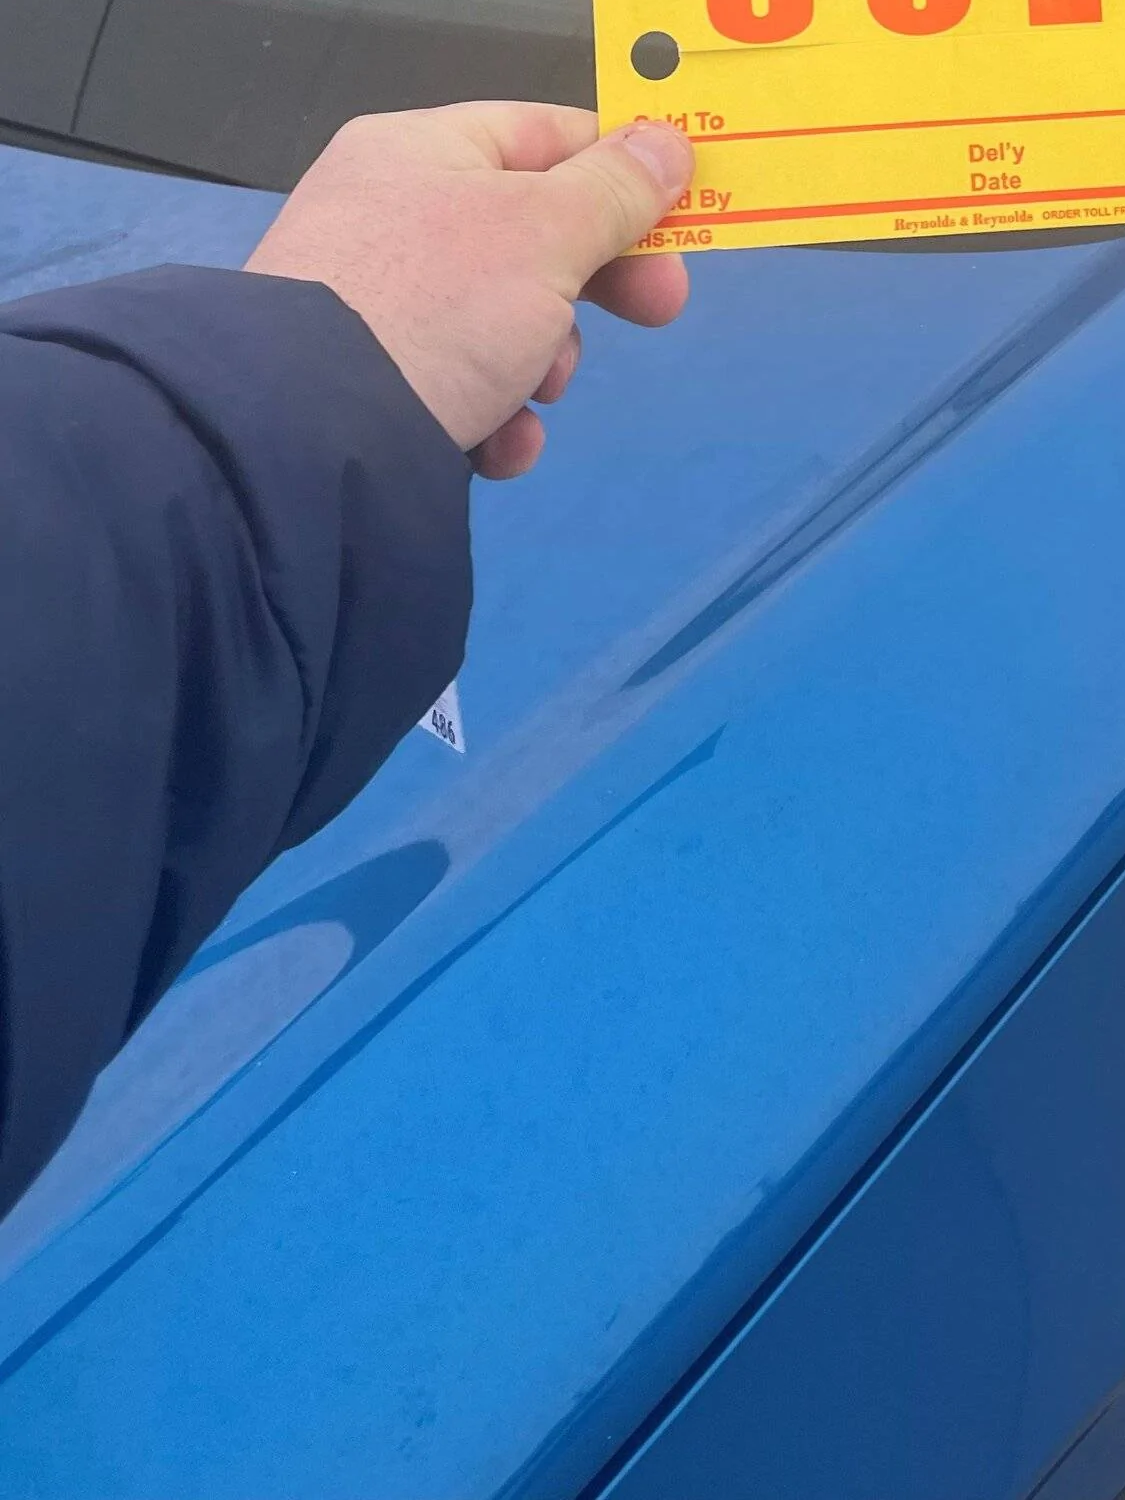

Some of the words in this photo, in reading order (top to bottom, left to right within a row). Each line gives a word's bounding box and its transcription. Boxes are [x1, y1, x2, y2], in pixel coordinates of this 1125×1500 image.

[634, 113, 689, 133] ld
[695, 112, 725, 132] To
[969, 142, 1025, 165] Del'y
[970, 172, 1022, 192] Date
[700, 189, 732, 211] By
[894, 215, 957, 234] Reynolds
[959, 213, 969, 227] &
[973, 210, 1034, 229] Reynolds
[1042, 207, 1081, 220] ORDER
[1084, 205, 1113, 217] TOLL
[637, 229, 713, 249] HS-TAG
[431, 709, 456, 745] 486
